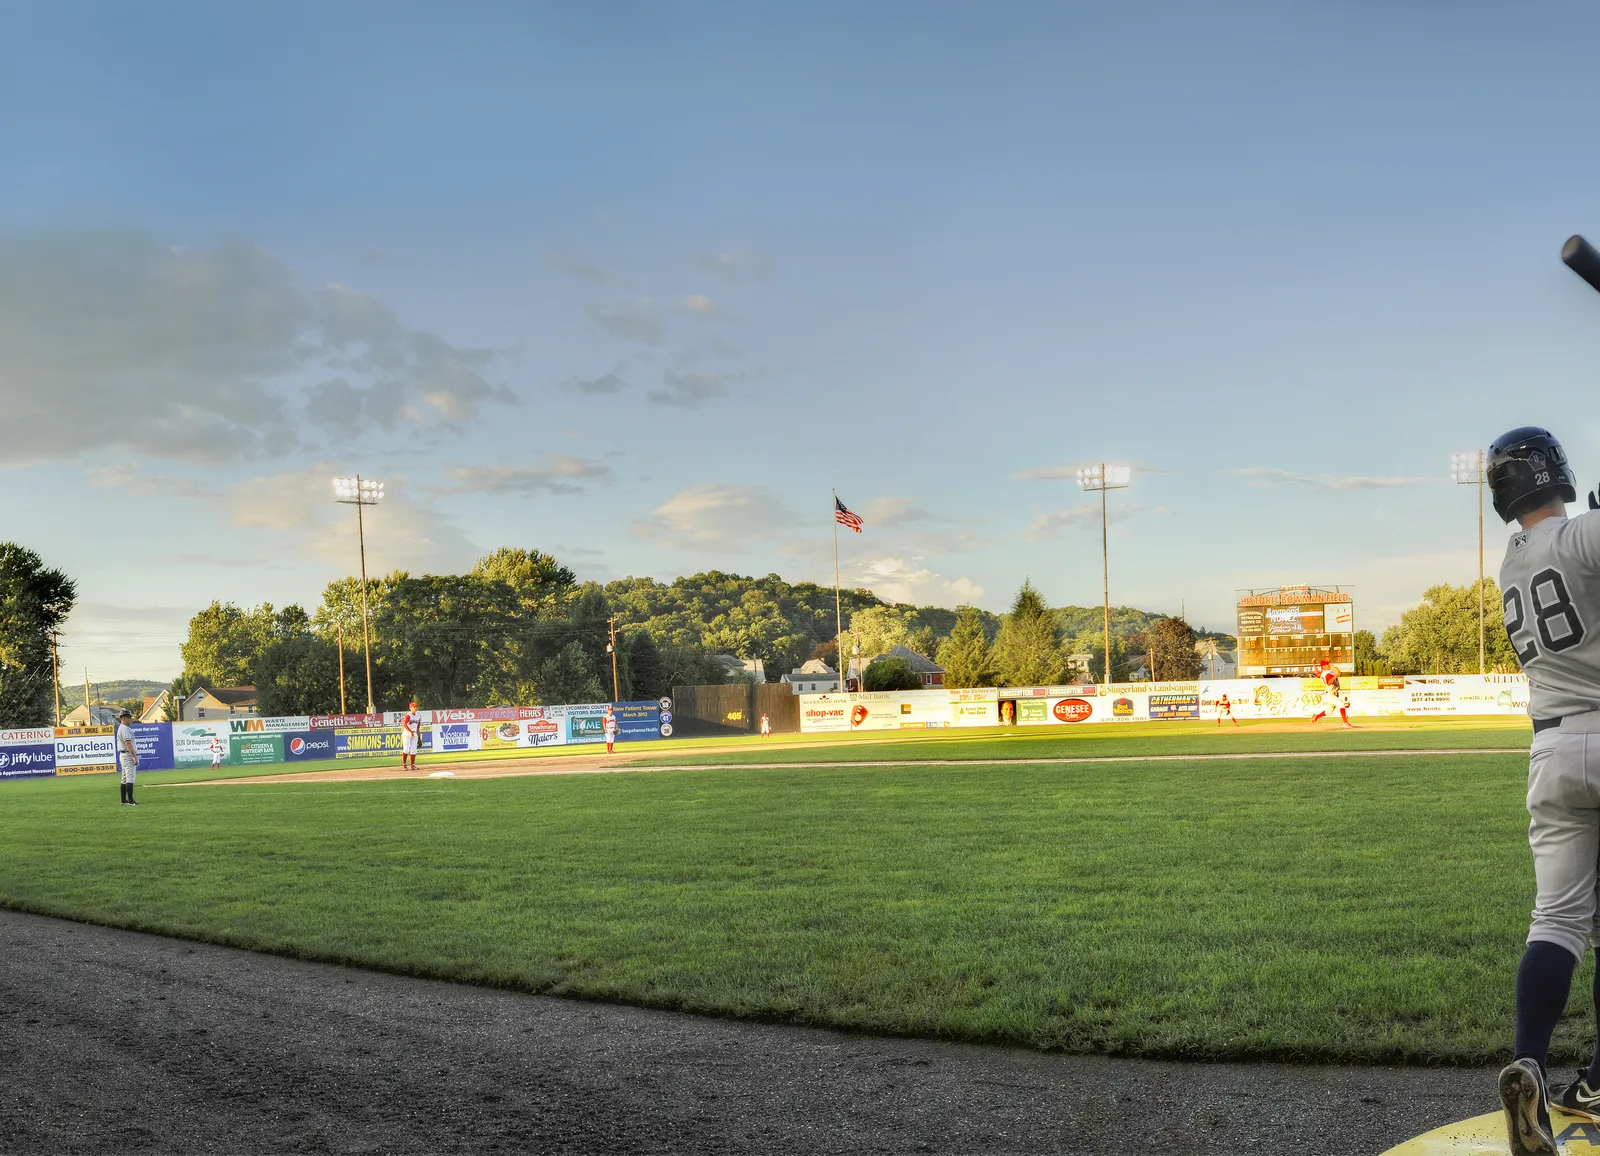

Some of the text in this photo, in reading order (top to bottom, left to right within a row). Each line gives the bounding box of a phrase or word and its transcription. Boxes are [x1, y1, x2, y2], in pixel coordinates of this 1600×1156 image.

[1535, 471, 1551, 486] 28
[1239, 593, 1349, 606] HISTORIC BOWMAN FIELD
[1502, 564, 1588, 668] 28
[1107, 683, 1198, 696] Slingerland's Landscaping
[1055, 704, 1090, 714] GENESEE
[309, 716, 344, 728] Genetti
[434, 709, 475, 723] Webb
[229, 719, 265, 733] WM
[1, 731, 52, 742] CATERING
[176, 738, 213, 747] SUN Orthopaedic
[528, 732, 558, 746] Maier's
[57, 742, 114, 753] Duraclean
[306, 740, 329, 750] pepsi
[2, 769, 32, 777] Appointment
[59, 765, 115, 773] 1-800-368-5368
